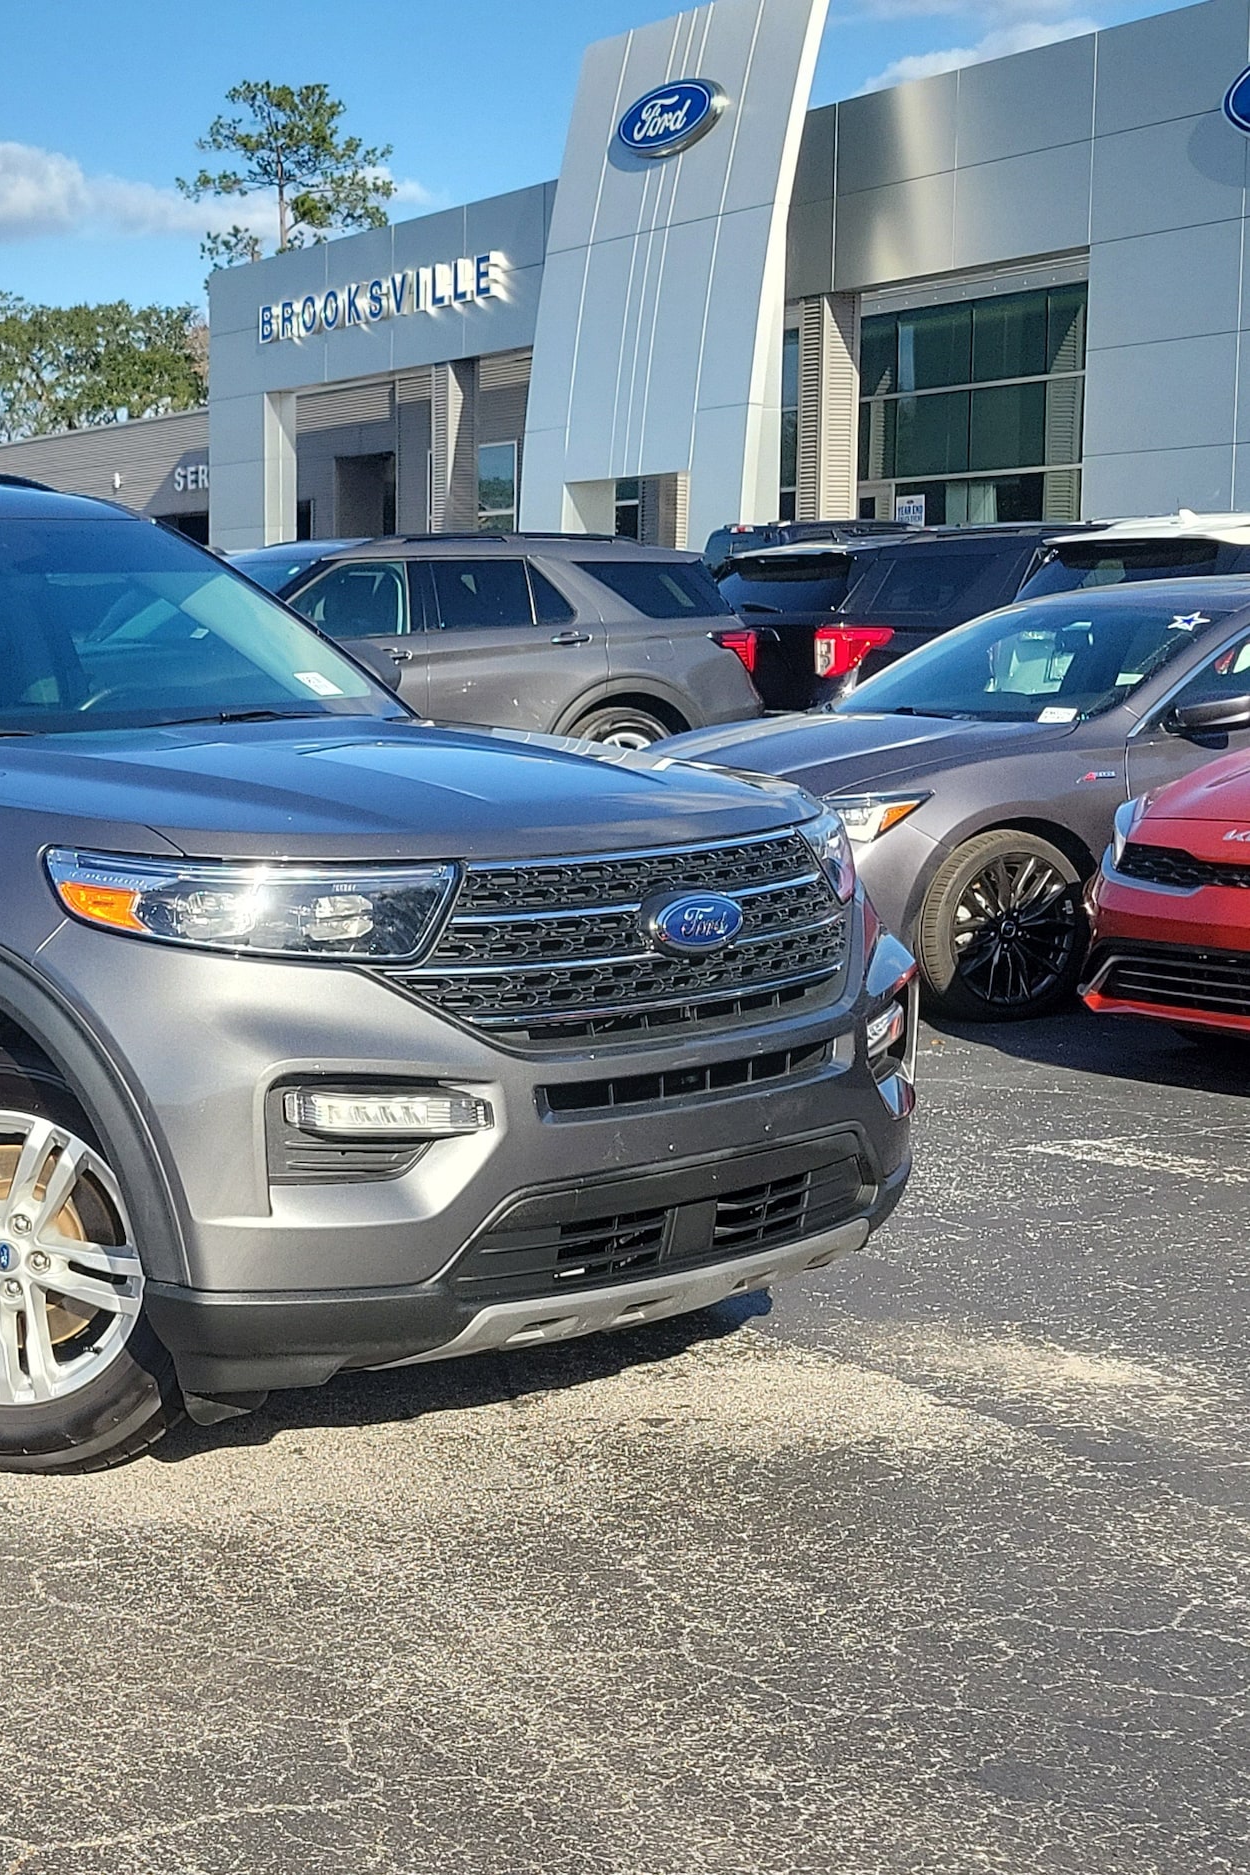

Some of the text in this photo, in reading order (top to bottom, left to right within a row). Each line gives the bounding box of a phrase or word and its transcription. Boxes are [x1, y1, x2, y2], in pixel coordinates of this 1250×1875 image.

[633, 95, 691, 141] Ford
[259, 252, 494, 344] BROOKSVILLE
[681, 906, 728, 937] Ford
